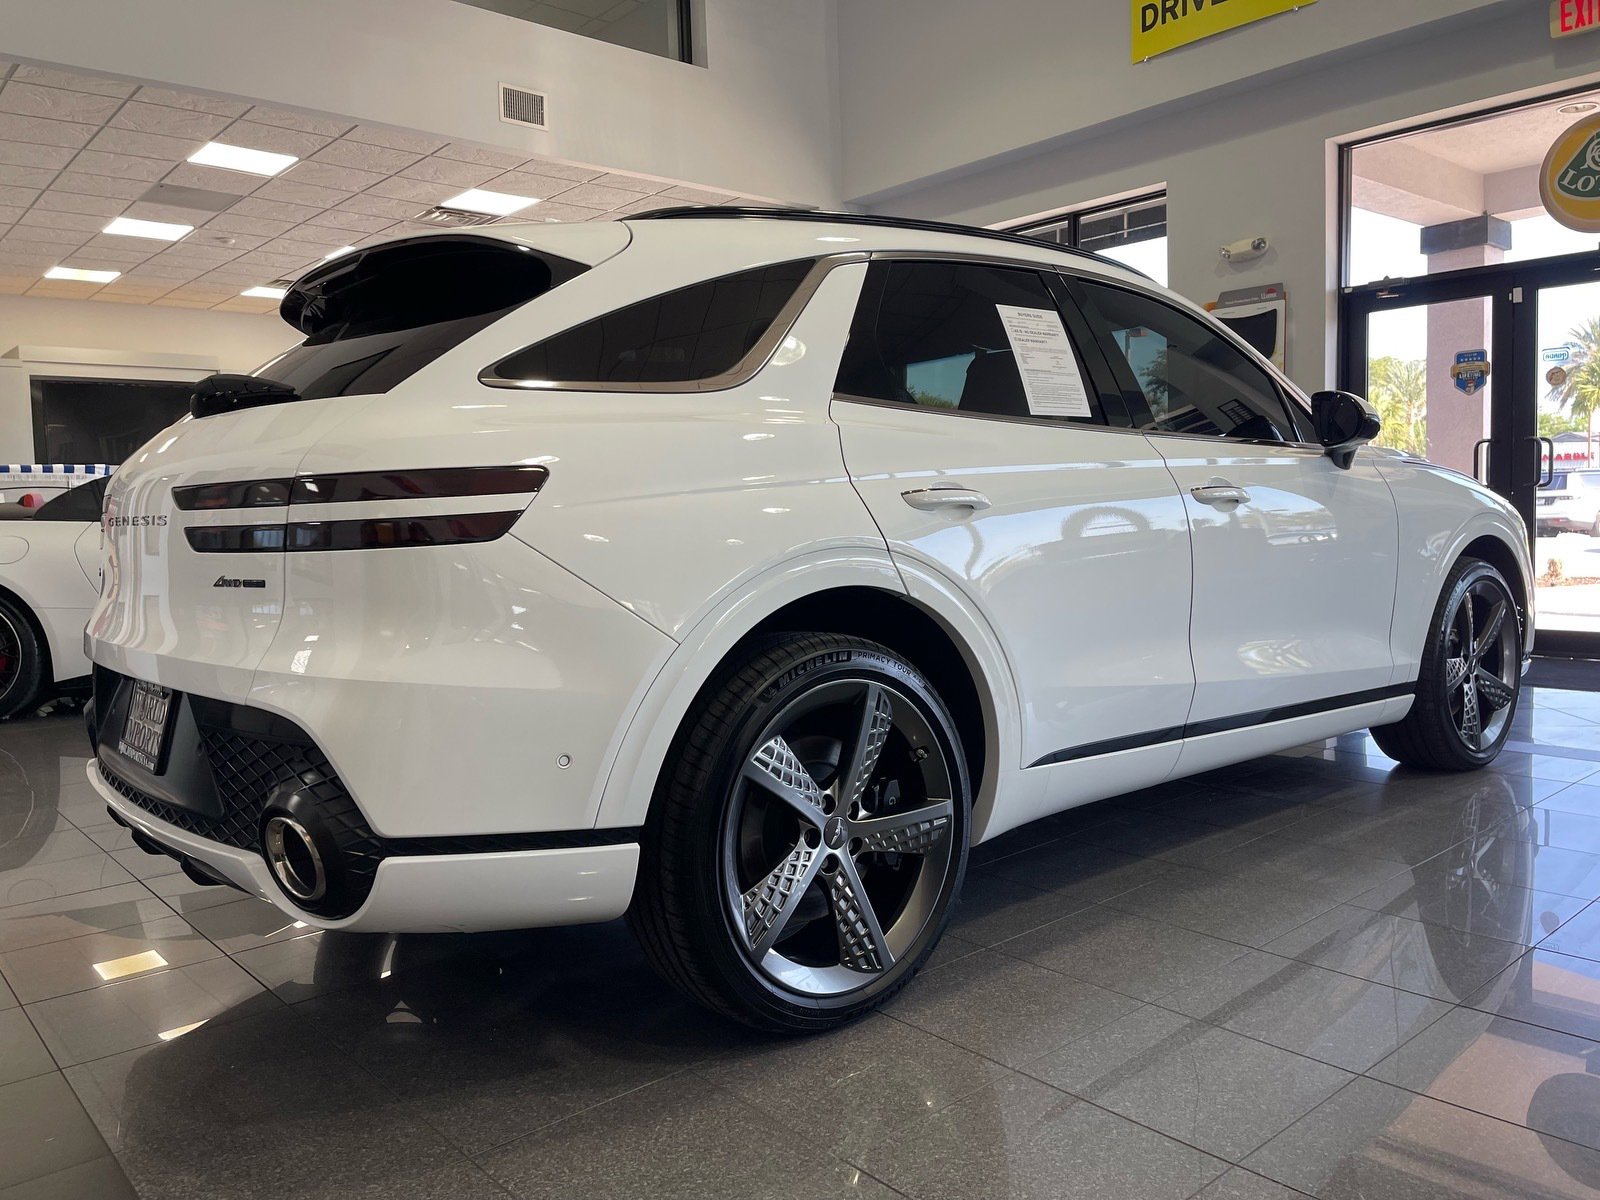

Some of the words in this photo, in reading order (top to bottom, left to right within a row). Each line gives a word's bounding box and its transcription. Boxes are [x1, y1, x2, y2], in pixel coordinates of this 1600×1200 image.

[1141, 0, 1228, 33] DRI
[1560, 0, 1600, 32] EXI
[108, 515, 168, 527] GENESIS
[778, 650, 848, 689] MICHELIN
[857, 650, 891, 665] PRIMACY
[893, 662, 912, 676] TOUR
